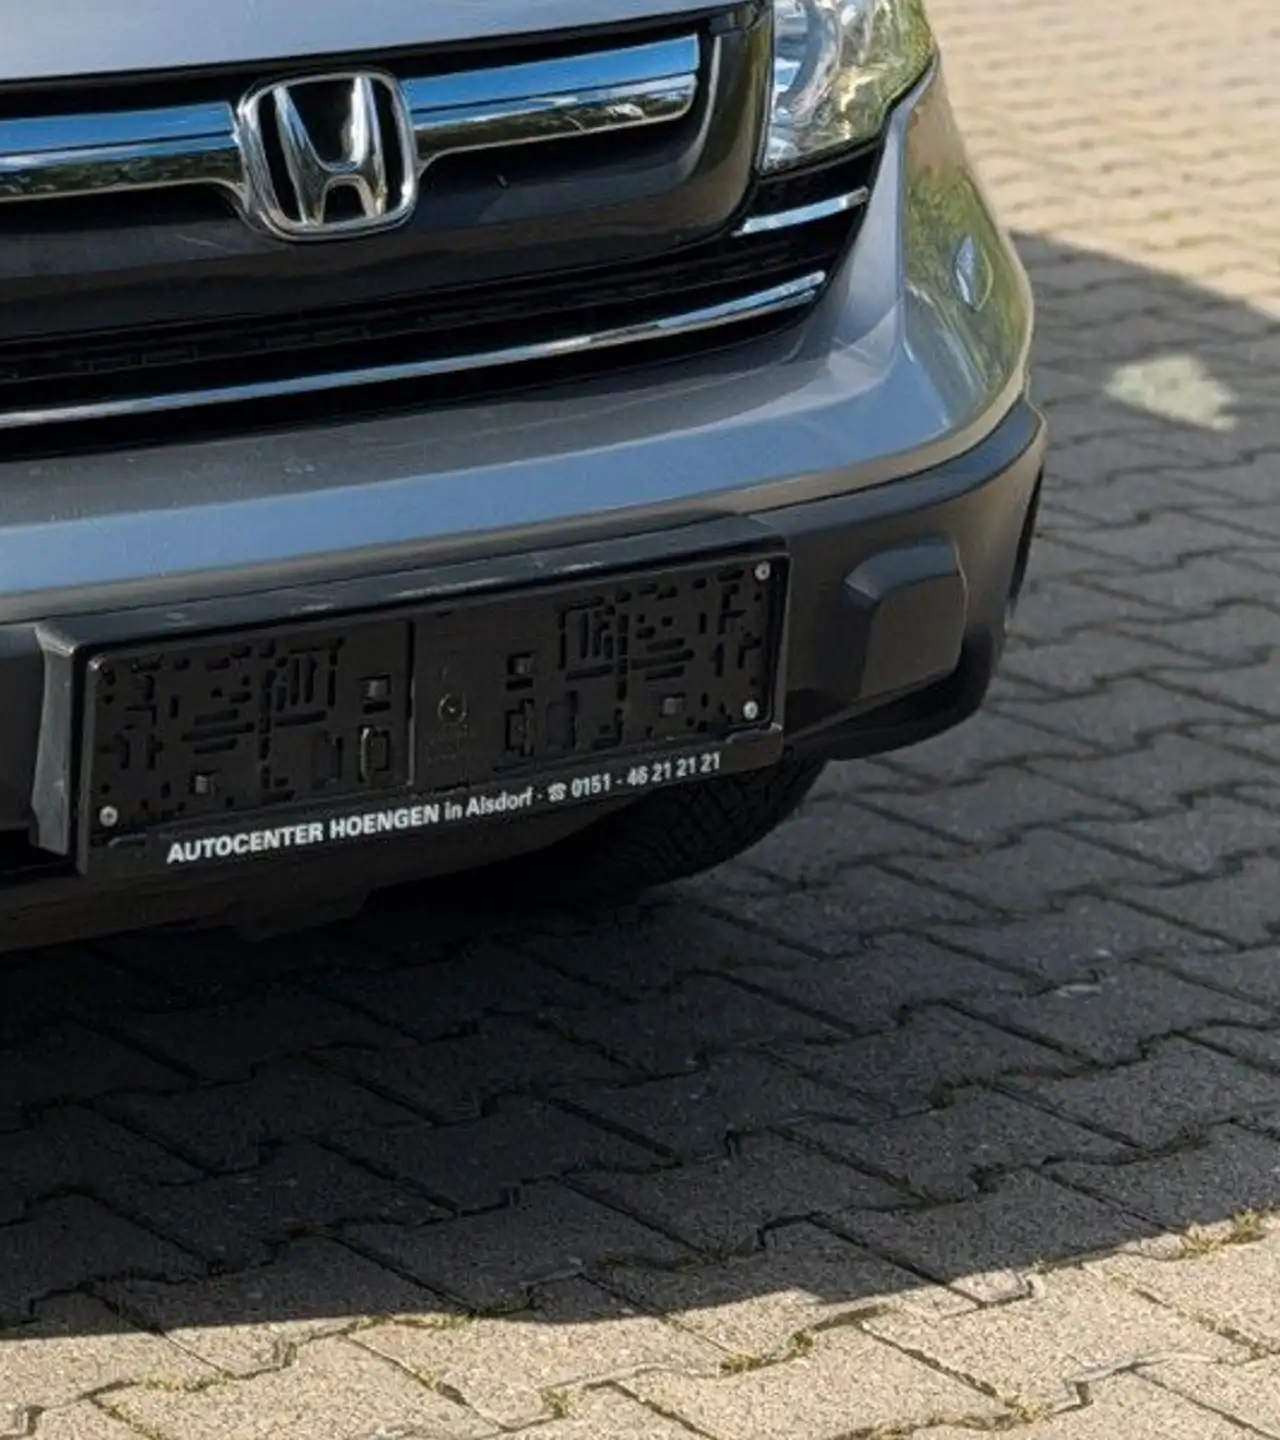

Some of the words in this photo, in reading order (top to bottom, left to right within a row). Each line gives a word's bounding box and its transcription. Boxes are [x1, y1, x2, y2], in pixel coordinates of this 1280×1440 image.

[166, 821, 325, 865] AUTOCENTER
[329, 803, 440, 840] HOENGEN
[443, 800, 463, 821] in
[465, 785, 534, 818] Alsdorf
[571, 773, 611, 798] 0151
[627, 765, 649, 787] 46
[651, 760, 672, 783] 21
[675, 756, 696, 778] 21
[699, 751, 721, 773] 21
